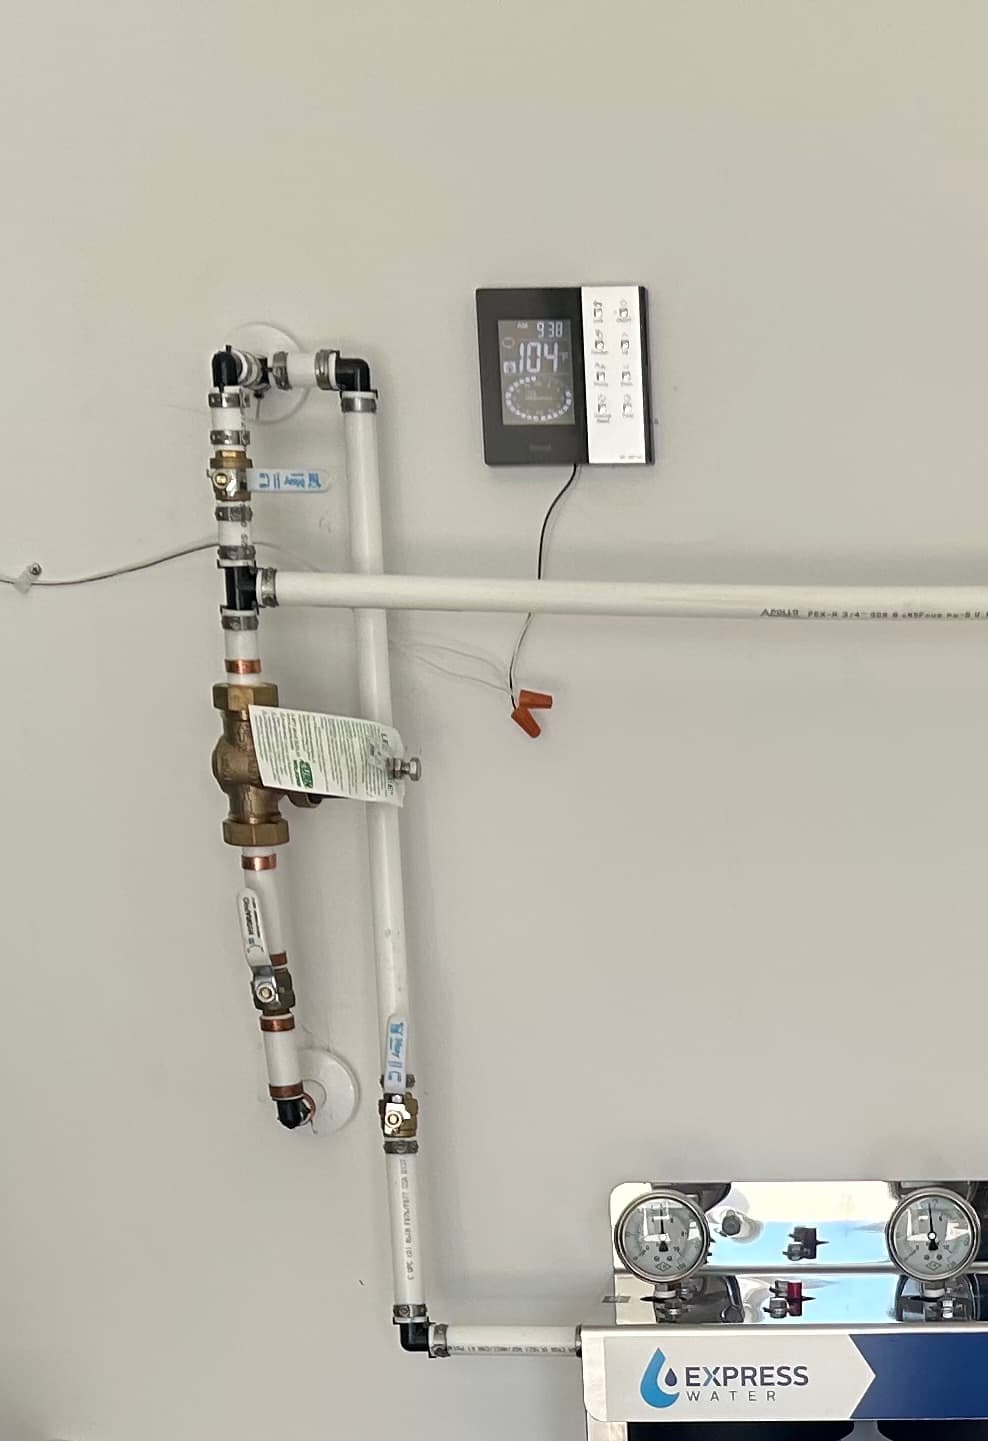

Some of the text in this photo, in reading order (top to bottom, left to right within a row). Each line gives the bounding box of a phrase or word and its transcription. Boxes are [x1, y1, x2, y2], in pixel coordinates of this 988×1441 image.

[519, 341, 558, 373] 104
[685, 1365, 809, 1387] EXPRESS
[687, 1390, 777, 1402] WATER
